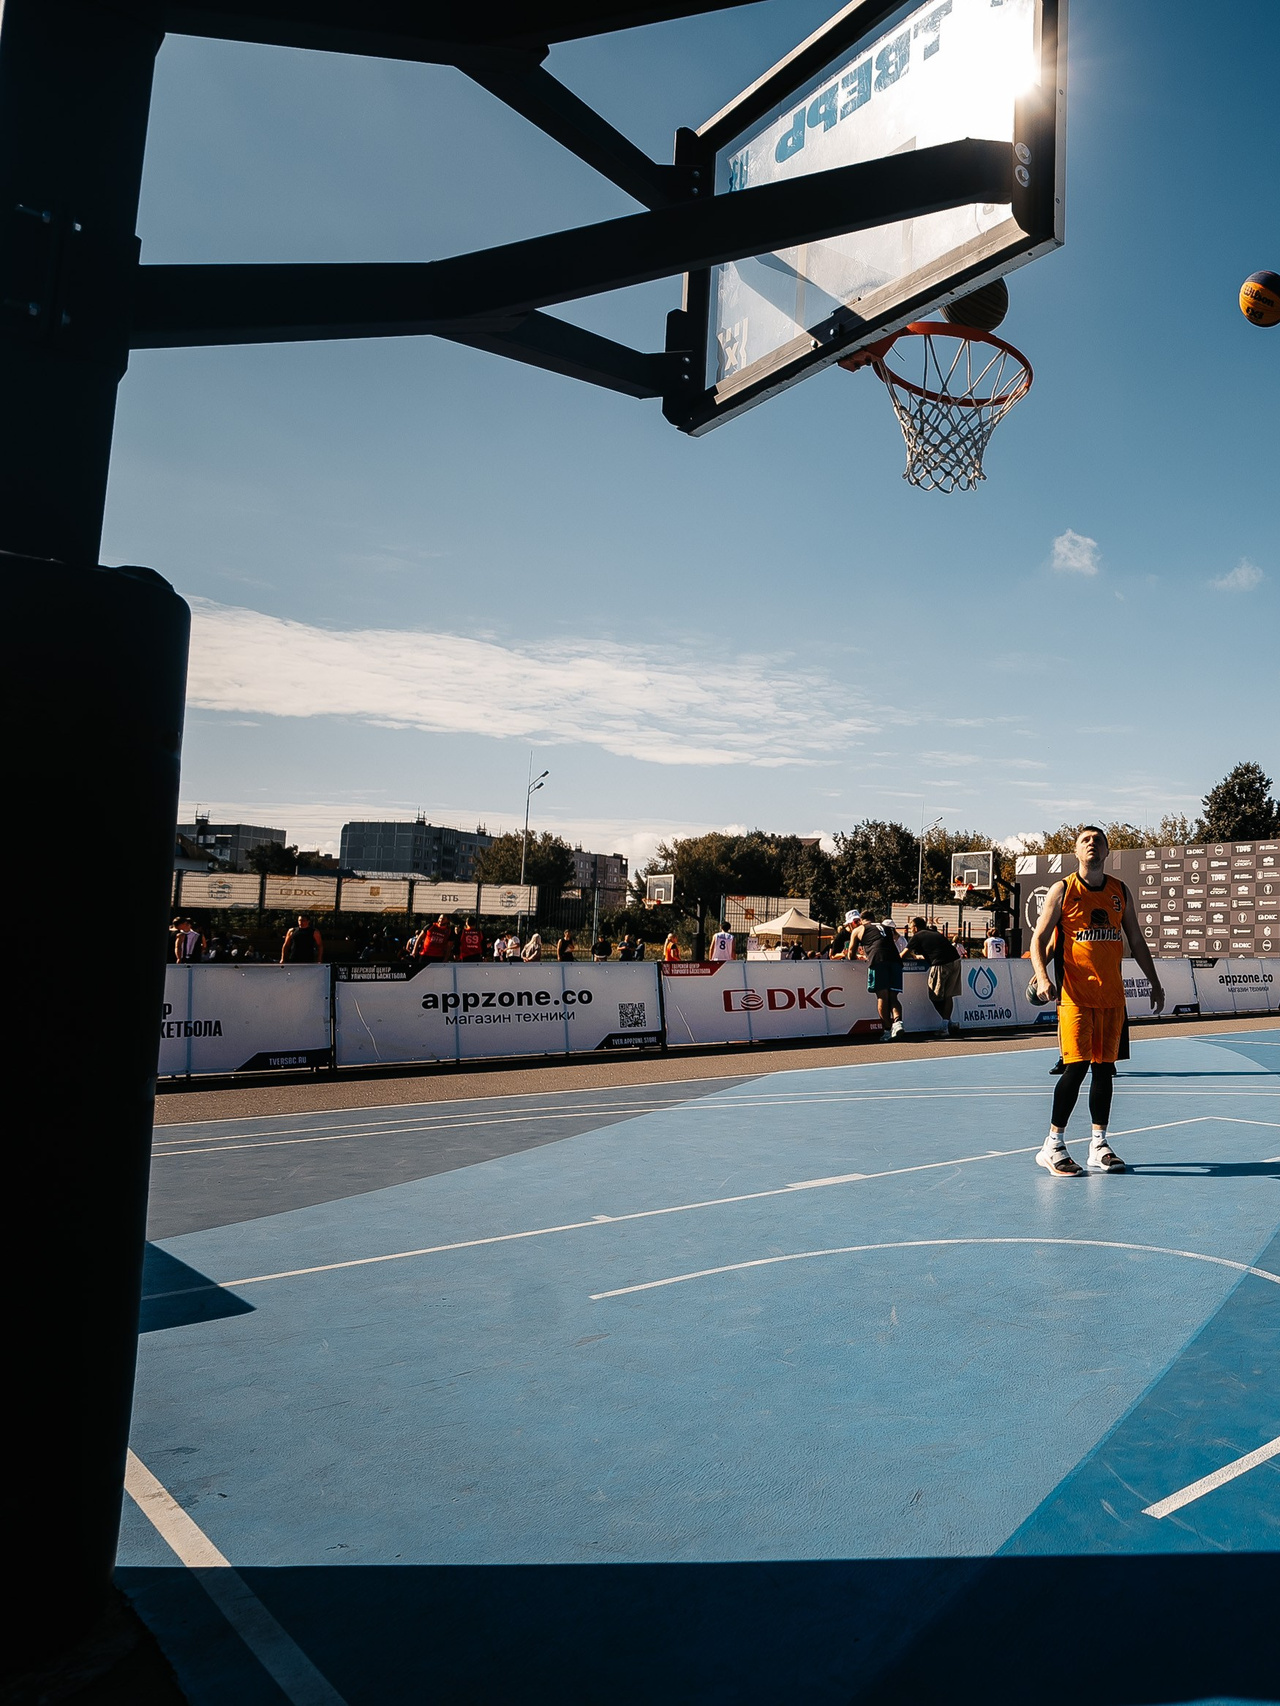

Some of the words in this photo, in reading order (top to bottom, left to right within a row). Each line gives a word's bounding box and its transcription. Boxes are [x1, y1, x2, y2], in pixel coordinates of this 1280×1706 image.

[441, 894, 459, 902] ВТБ
[1111, 895, 1122, 912] 3
[465, 935, 479, 945] 69
[719, 941, 726, 950] 8
[995, 943, 1001, 953] 5
[1218, 973, 1273, 986] appzone.co
[421, 989, 593, 1013] appzone.co
[767, 987, 845, 1010] DKC
[446, 1014, 511, 1026] магазин
[516, 1011, 575, 1023] техники
[964, 1007, 1012, 1022] АКВА-ЛАЙФ
